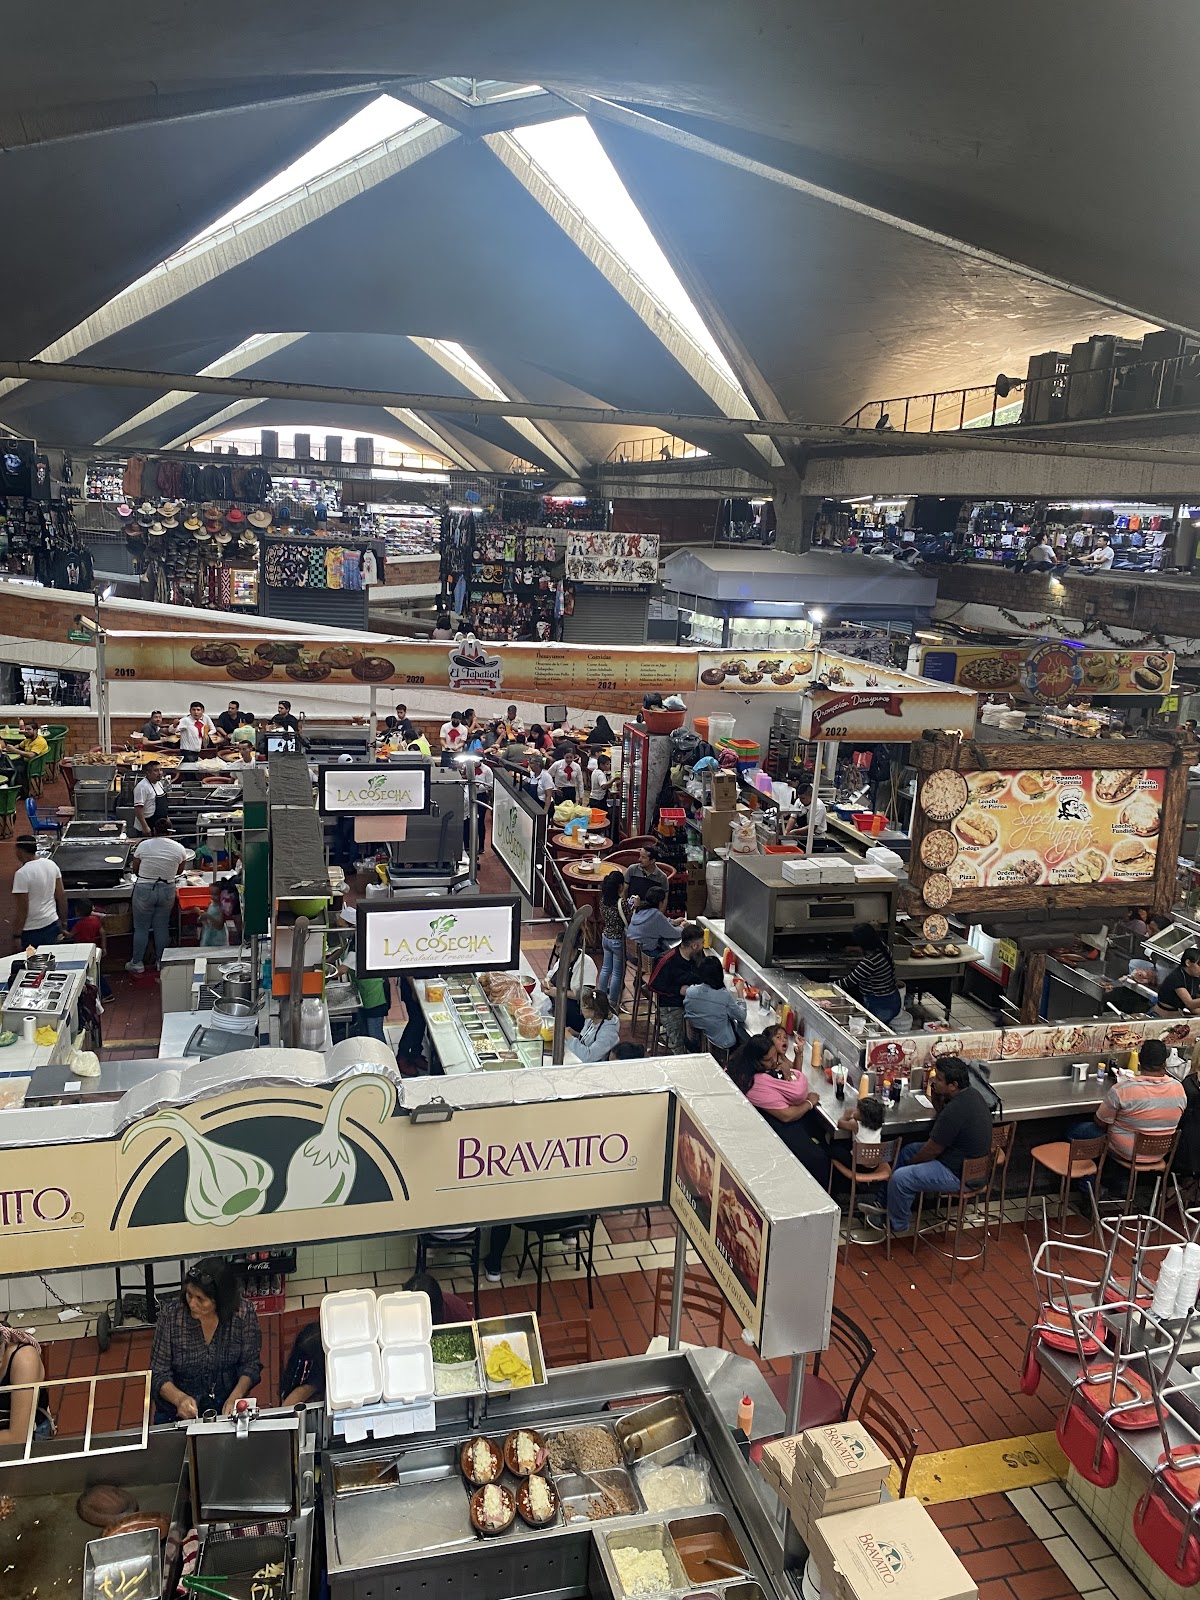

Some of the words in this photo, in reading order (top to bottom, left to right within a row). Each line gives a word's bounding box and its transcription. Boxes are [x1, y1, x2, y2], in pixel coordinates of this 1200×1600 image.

[114, 668, 135, 677] 2019
[406, 675, 425, 684] 2020
[449, 669, 460, 678] El
[598, 681, 617, 689] 2021
[813, 699, 850, 722] Promoción
[850, 694, 891, 706] Desayunos
[825, 727, 848, 736] 2022
[337, 789, 357, 802] LA
[925, 805, 964, 820] Familiar
[383, 938, 414, 957] LA
[415, 934, 495, 954] COSECHA
[399, 953, 439, 962] Ensaladas
[441, 952, 475, 961] Frescas
[458, 1133, 629, 1180] BRAVATTO
[725, 1274, 753, 1324] fronteras
[823, 1426, 859, 1469] BRAVATTO
[1002, 1450, 1040, 1469] GAS
[858, 1533, 895, 1584] BRAVATTO
[901, 1542, 915, 1562] PIZZAS
